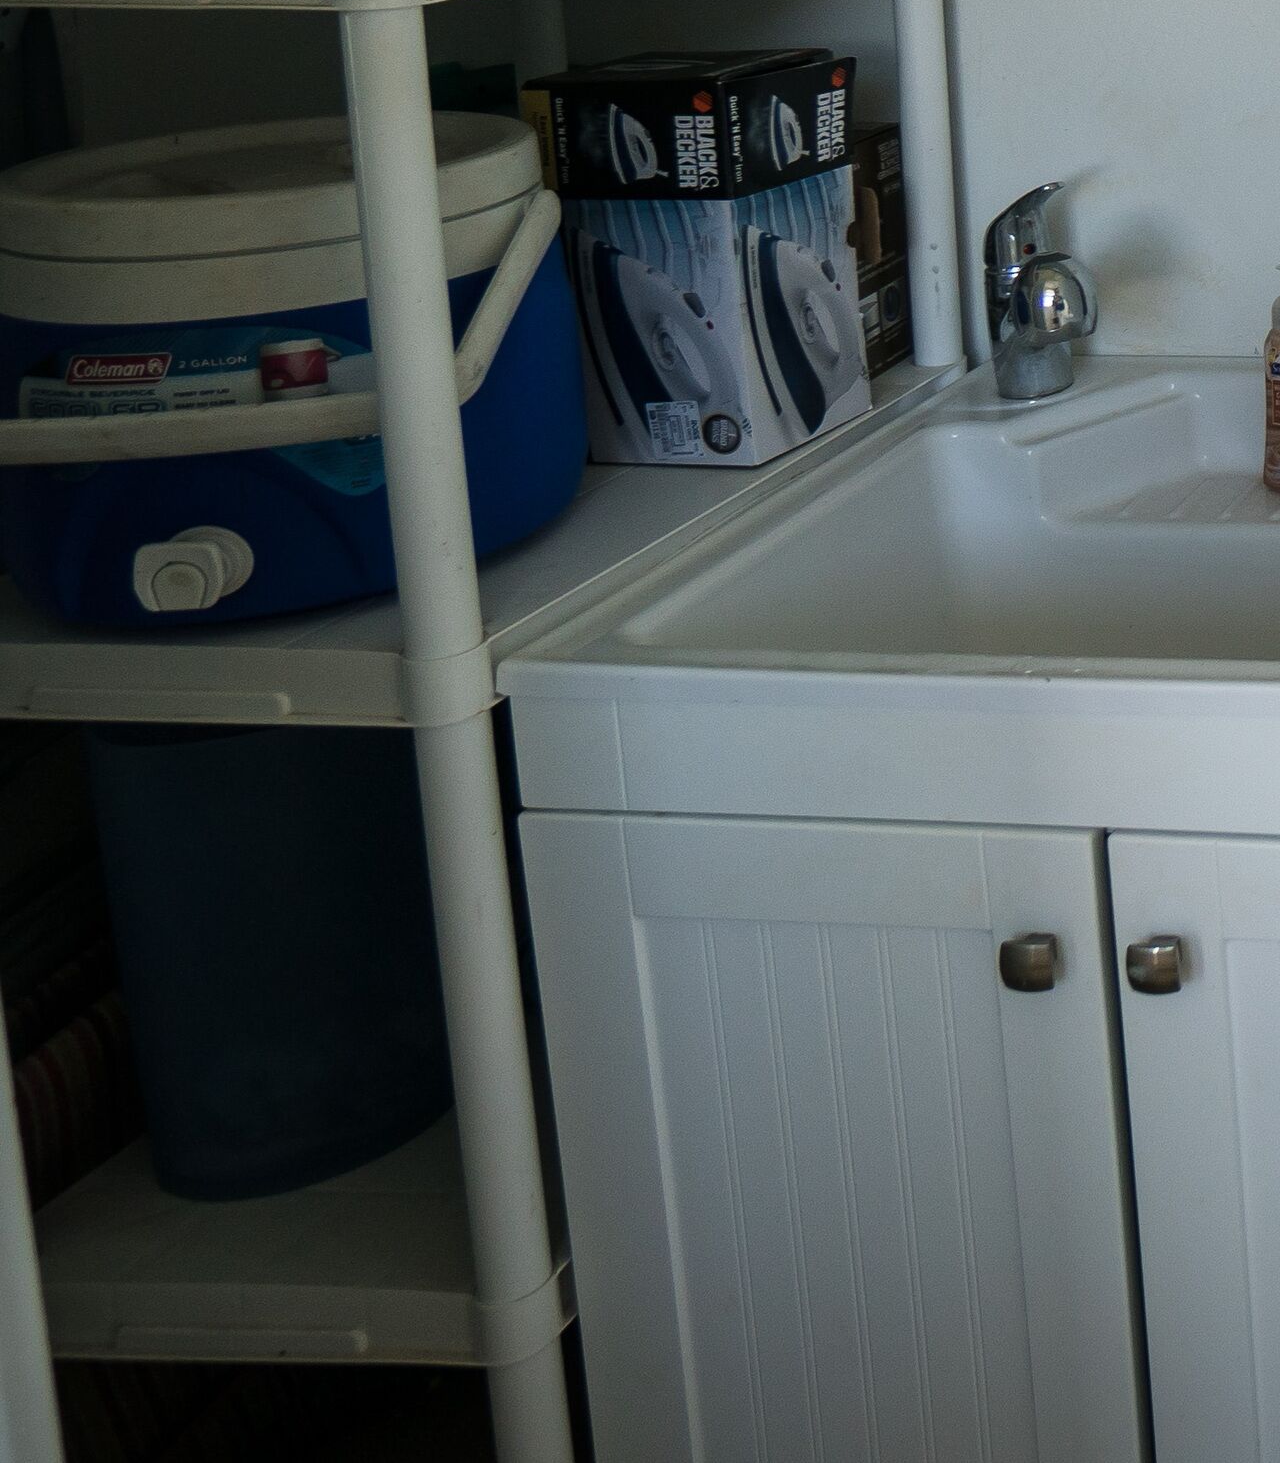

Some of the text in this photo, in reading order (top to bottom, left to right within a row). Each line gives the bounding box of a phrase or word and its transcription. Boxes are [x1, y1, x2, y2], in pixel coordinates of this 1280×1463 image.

[555, 97, 564, 123] Quick
[816, 92, 831, 162] DECKER
[673, 115, 698, 188] DECKER
[729, 95, 739, 122] Quick
[735, 164, 743, 183] Iron
[72, 357, 145, 378] Coleman
[177, 355, 247, 369] 2 GALLON
